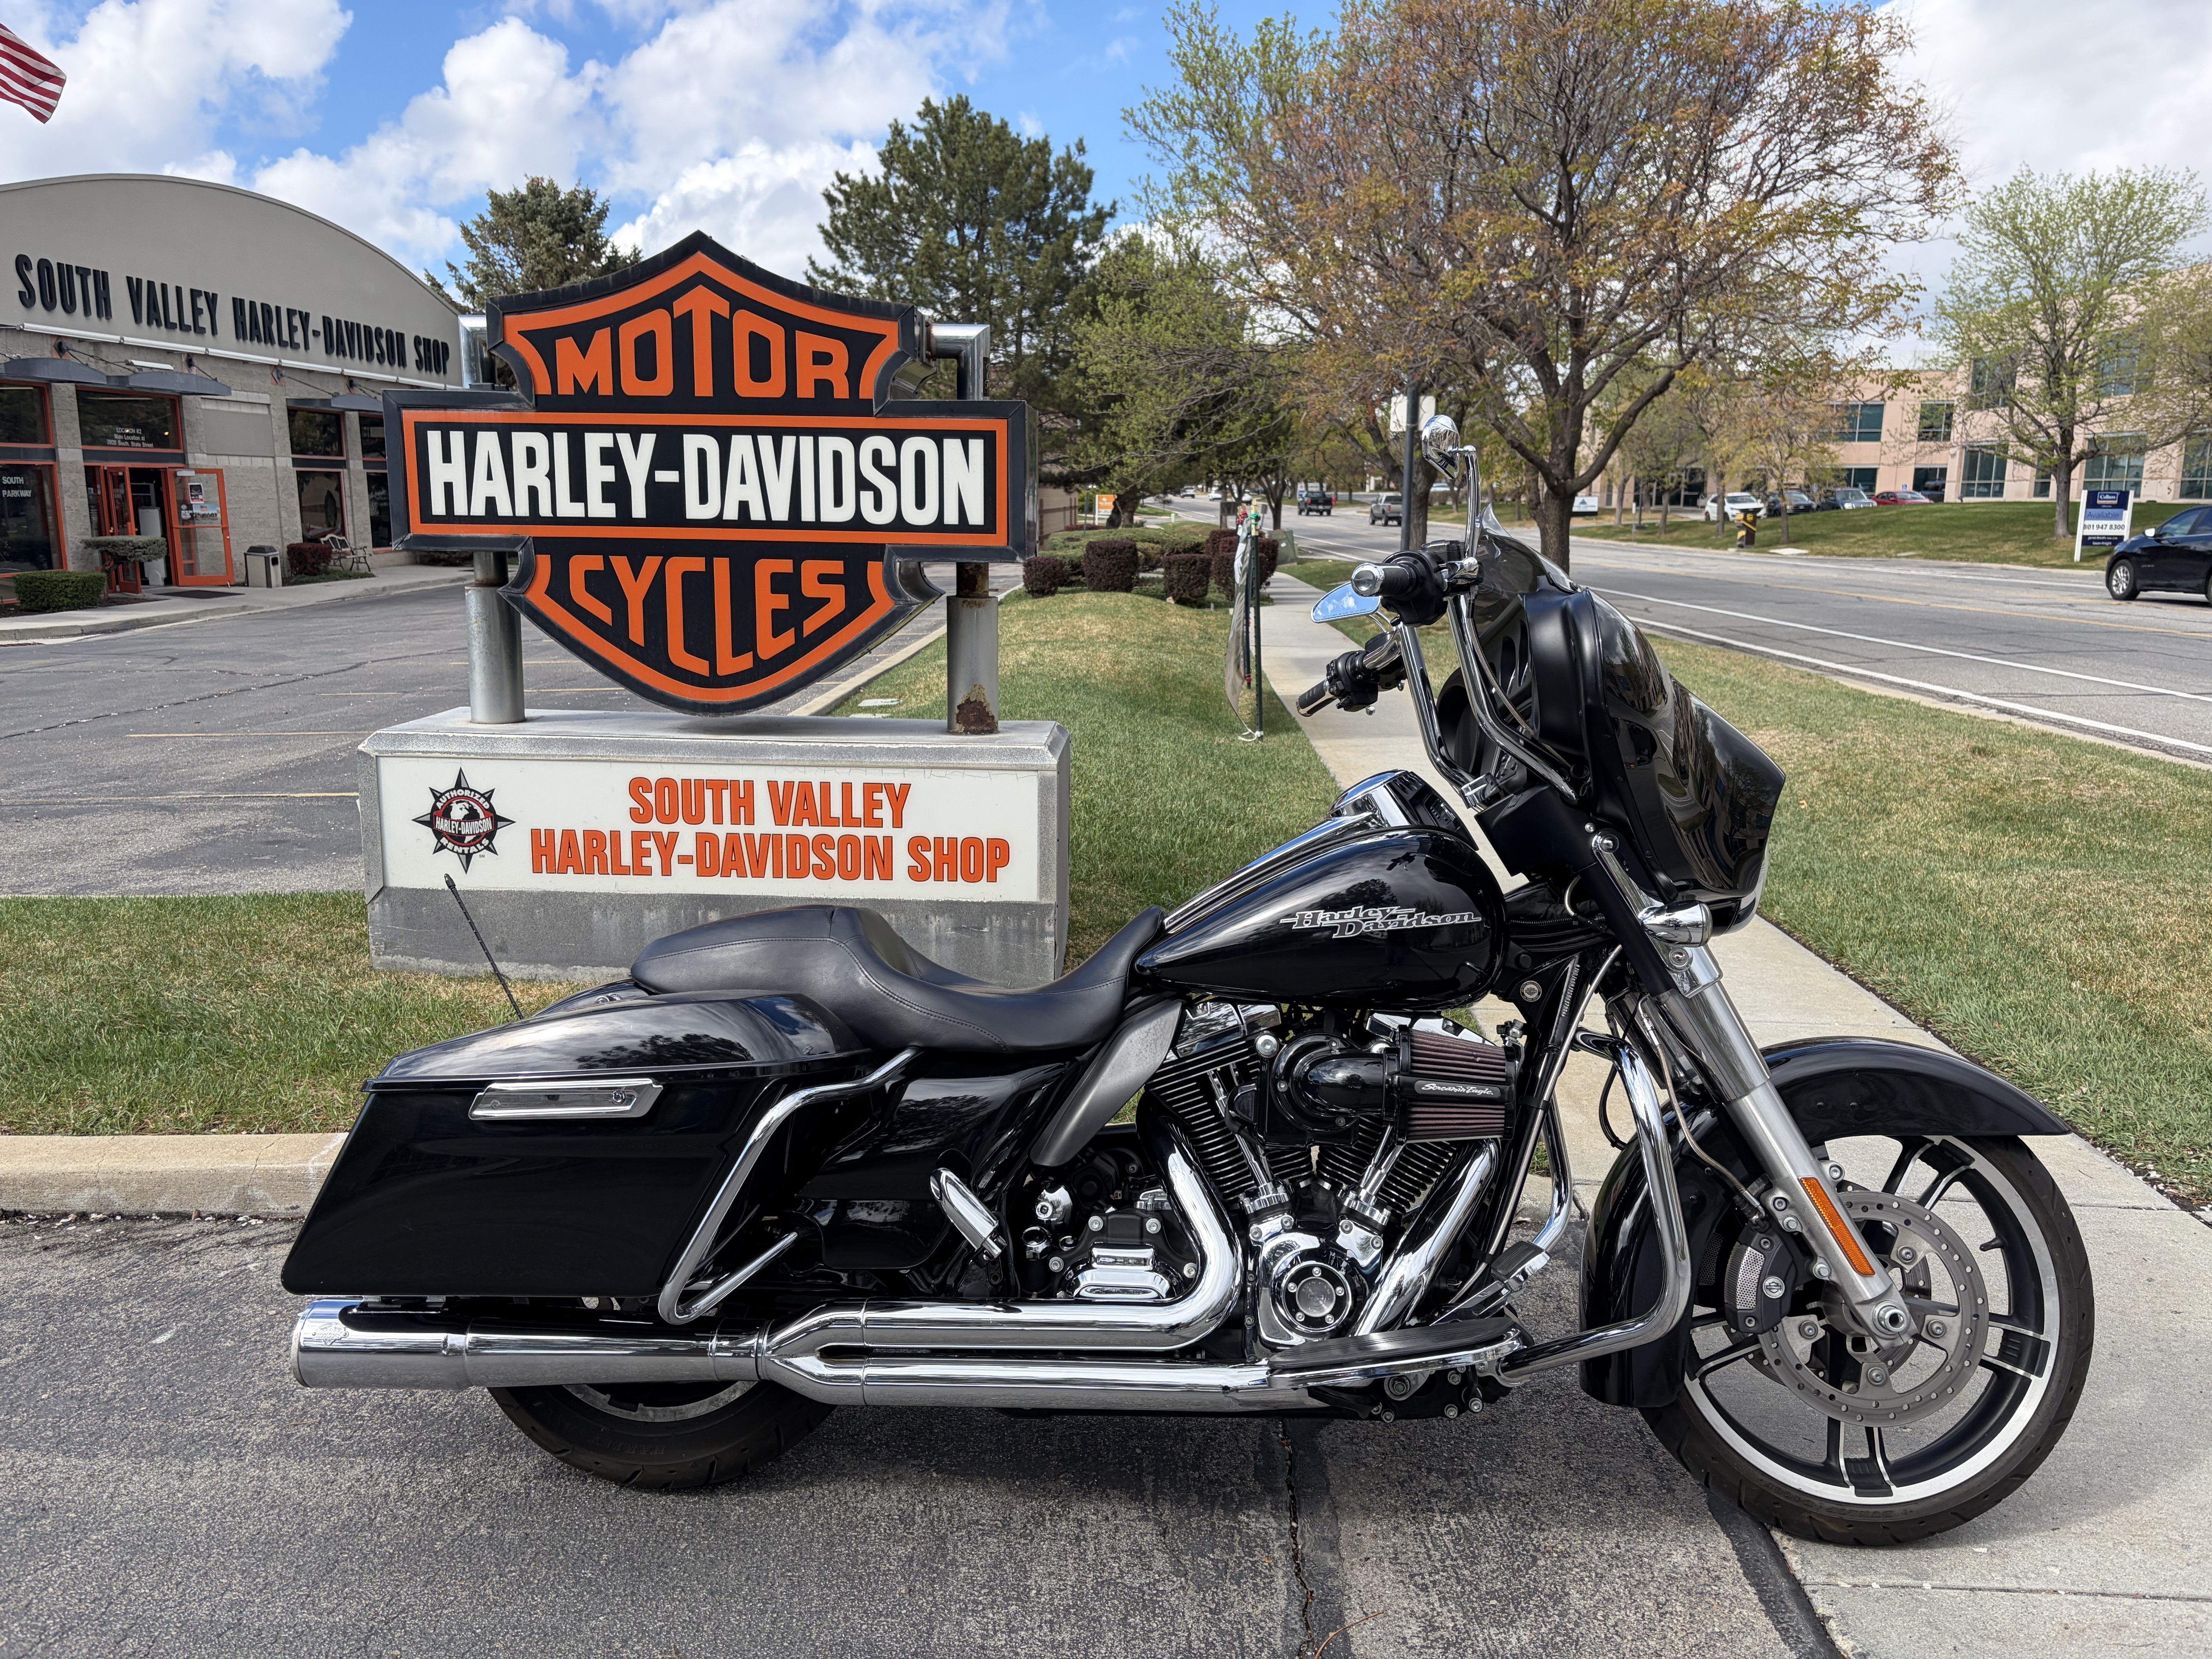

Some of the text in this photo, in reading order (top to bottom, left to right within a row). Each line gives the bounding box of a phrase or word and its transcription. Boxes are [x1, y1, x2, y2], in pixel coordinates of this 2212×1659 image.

[15, 254, 450, 376] SOUTH VALLEY HARLEY-DAVIDSON SHOP
[555, 285, 850, 399] MOTOR
[426, 430, 985, 526] HARLEY-DAVIDSON
[2, 489, 32, 498] PARKWAY
[569, 555, 846, 677] CYCLES
[436, 789, 490, 810] AUTHORIZED
[629, 777, 911, 828] SOUTH VALLEY
[435, 816, 493, 835] HARLEY-DAVIDSON
[440, 837, 489, 854] RENTALS
[531, 829, 1010, 883] HARLEY-DAVIDSON SHOP
[1279, 905, 1416, 929] Harley
[1322, 912, 1481, 939] Davidson
[1826, 1507, 1893, 1519] DUNLOP
